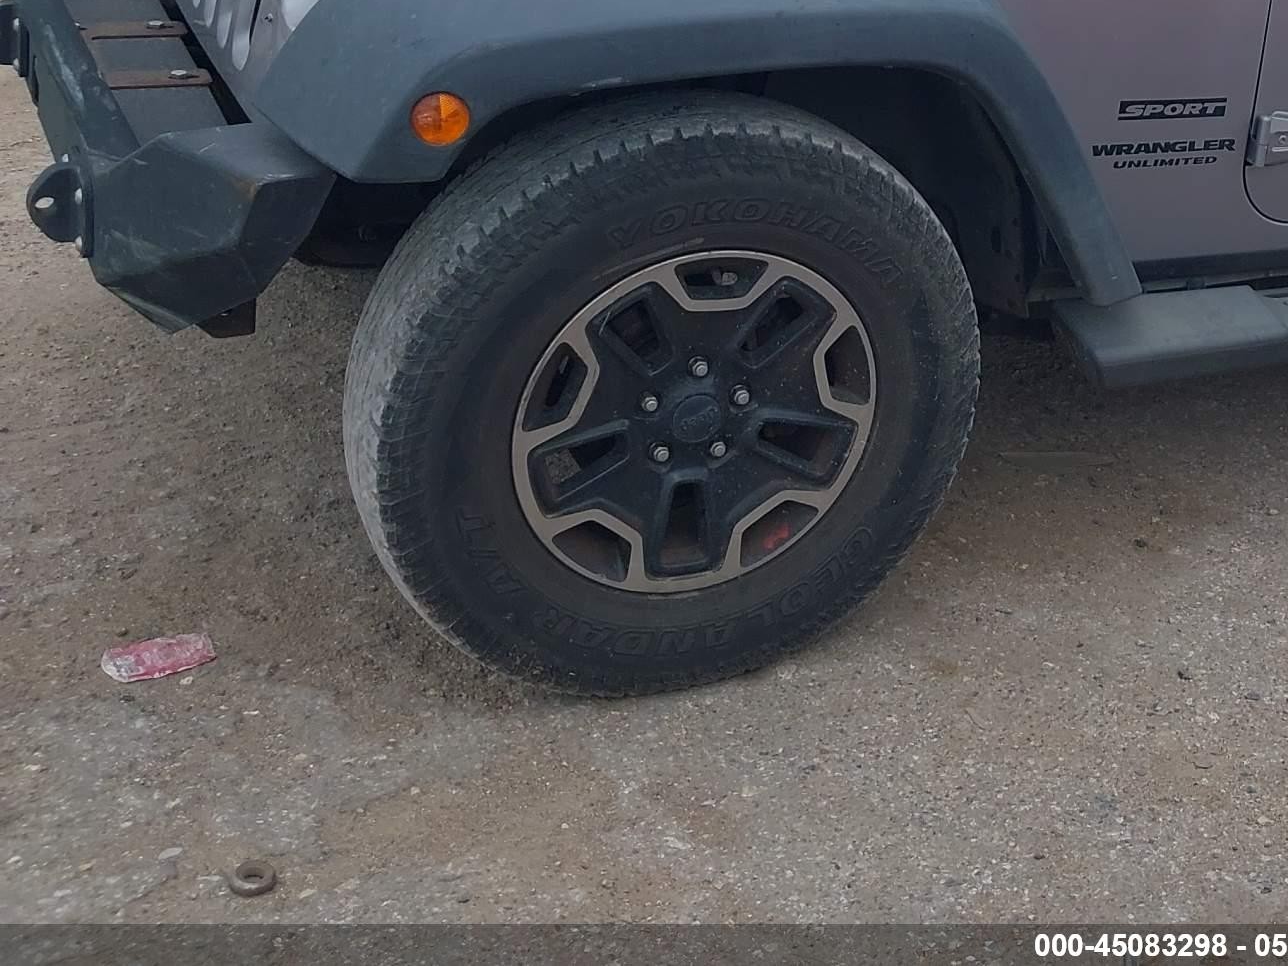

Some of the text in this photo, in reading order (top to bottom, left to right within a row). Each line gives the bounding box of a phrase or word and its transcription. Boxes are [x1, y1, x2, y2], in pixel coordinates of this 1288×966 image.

[1122, 101, 1227, 118] SPORT
[1091, 138, 1236, 157] WRANGLER
[1113, 155, 1218, 169] UNLIMITED
[606, 196, 907, 290] YOKOHAMA
